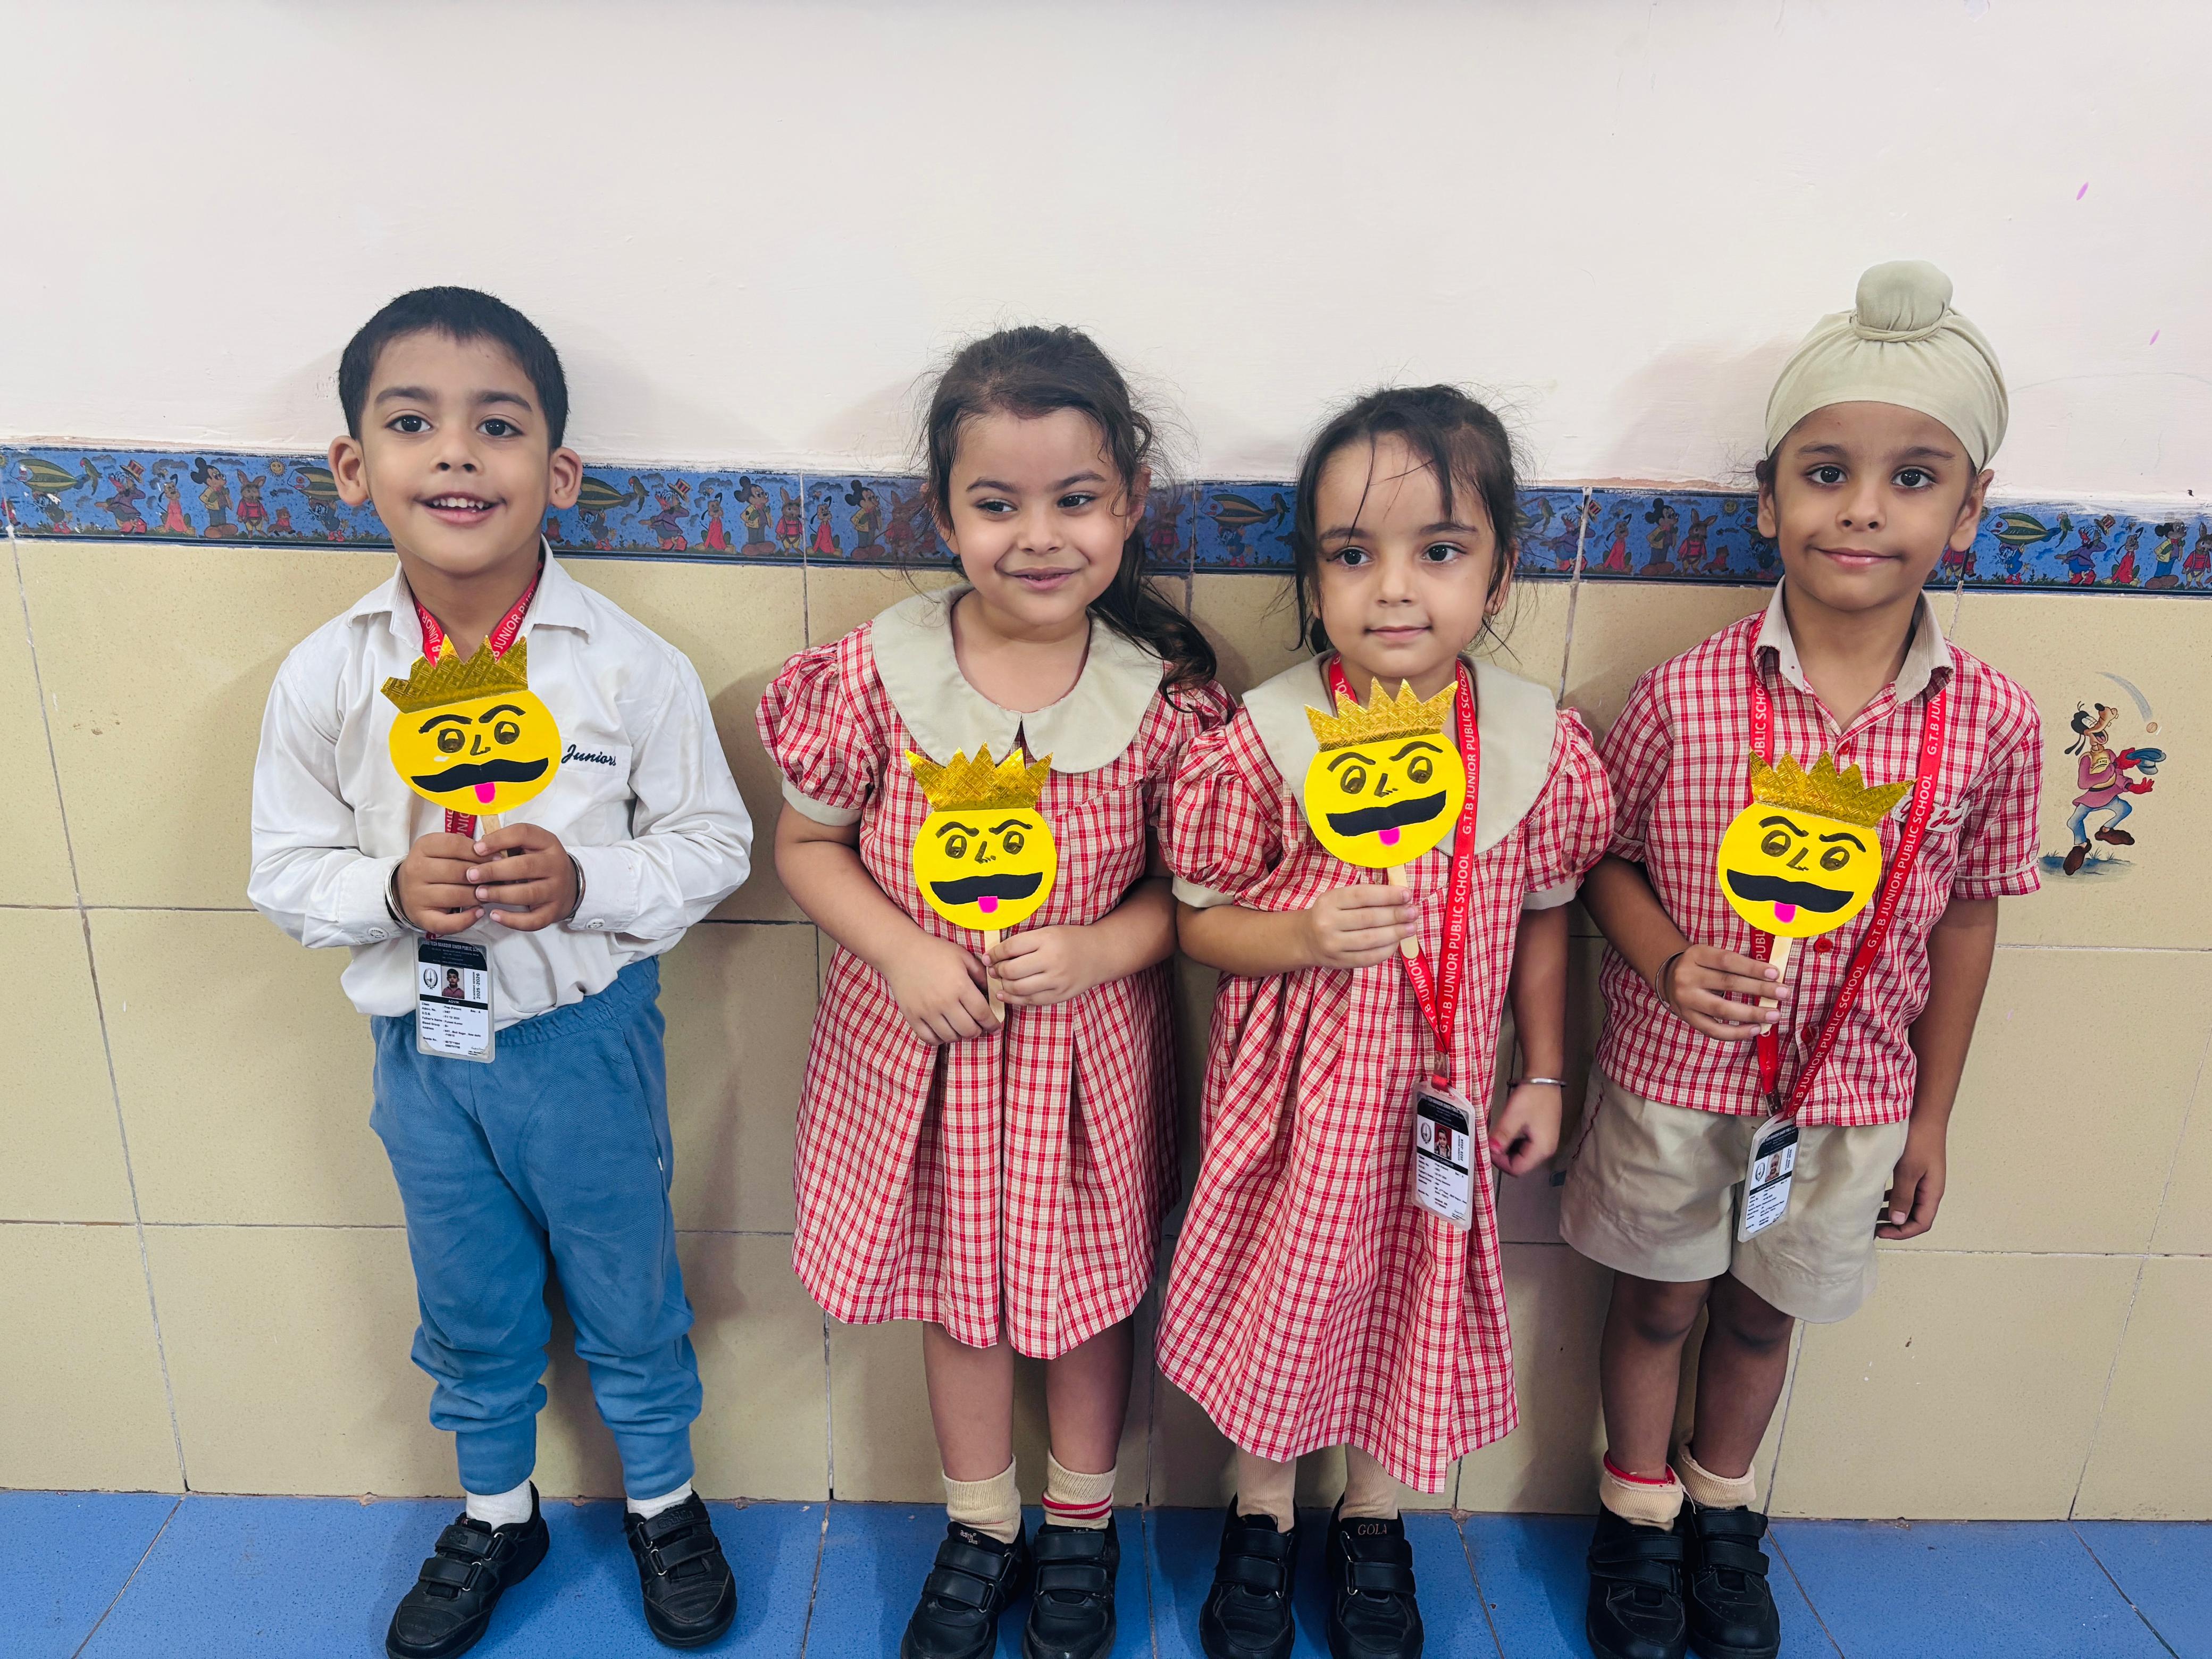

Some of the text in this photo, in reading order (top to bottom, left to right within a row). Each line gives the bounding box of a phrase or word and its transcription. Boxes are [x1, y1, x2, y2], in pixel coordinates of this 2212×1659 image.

[422, 614, 439, 644] JUNIOR
[494, 614, 521, 650] JUNIOR
[1462, 711, 1476, 751] PUBLIC
[1755, 722, 1766, 758] UBLIC
[1926, 694, 1941, 756] G.T.B JUN
[1466, 753, 1476, 801] JUNIOR
[1462, 803, 1474, 835] G.T.B
[1867, 918, 1886, 948] G.T.B
[1881, 872, 1904, 916] JUNIOR
[1898, 826, 1919, 869] PUBLIC
[1913, 774, 1933, 824] SCHOOL
[1439, 853, 1470, 1033] G.T.B JUNIOR PUBLIC SCHOOL
[1407, 958, 1430, 1002] JUNIOR
[1800, 1051, 1825, 1089] JUNIOR
[1820, 1011, 1844, 1049] PUBLIC
[1839, 965, 1866, 1009] SCHOOL
[1358, 1523, 1387, 1535] GOLA
